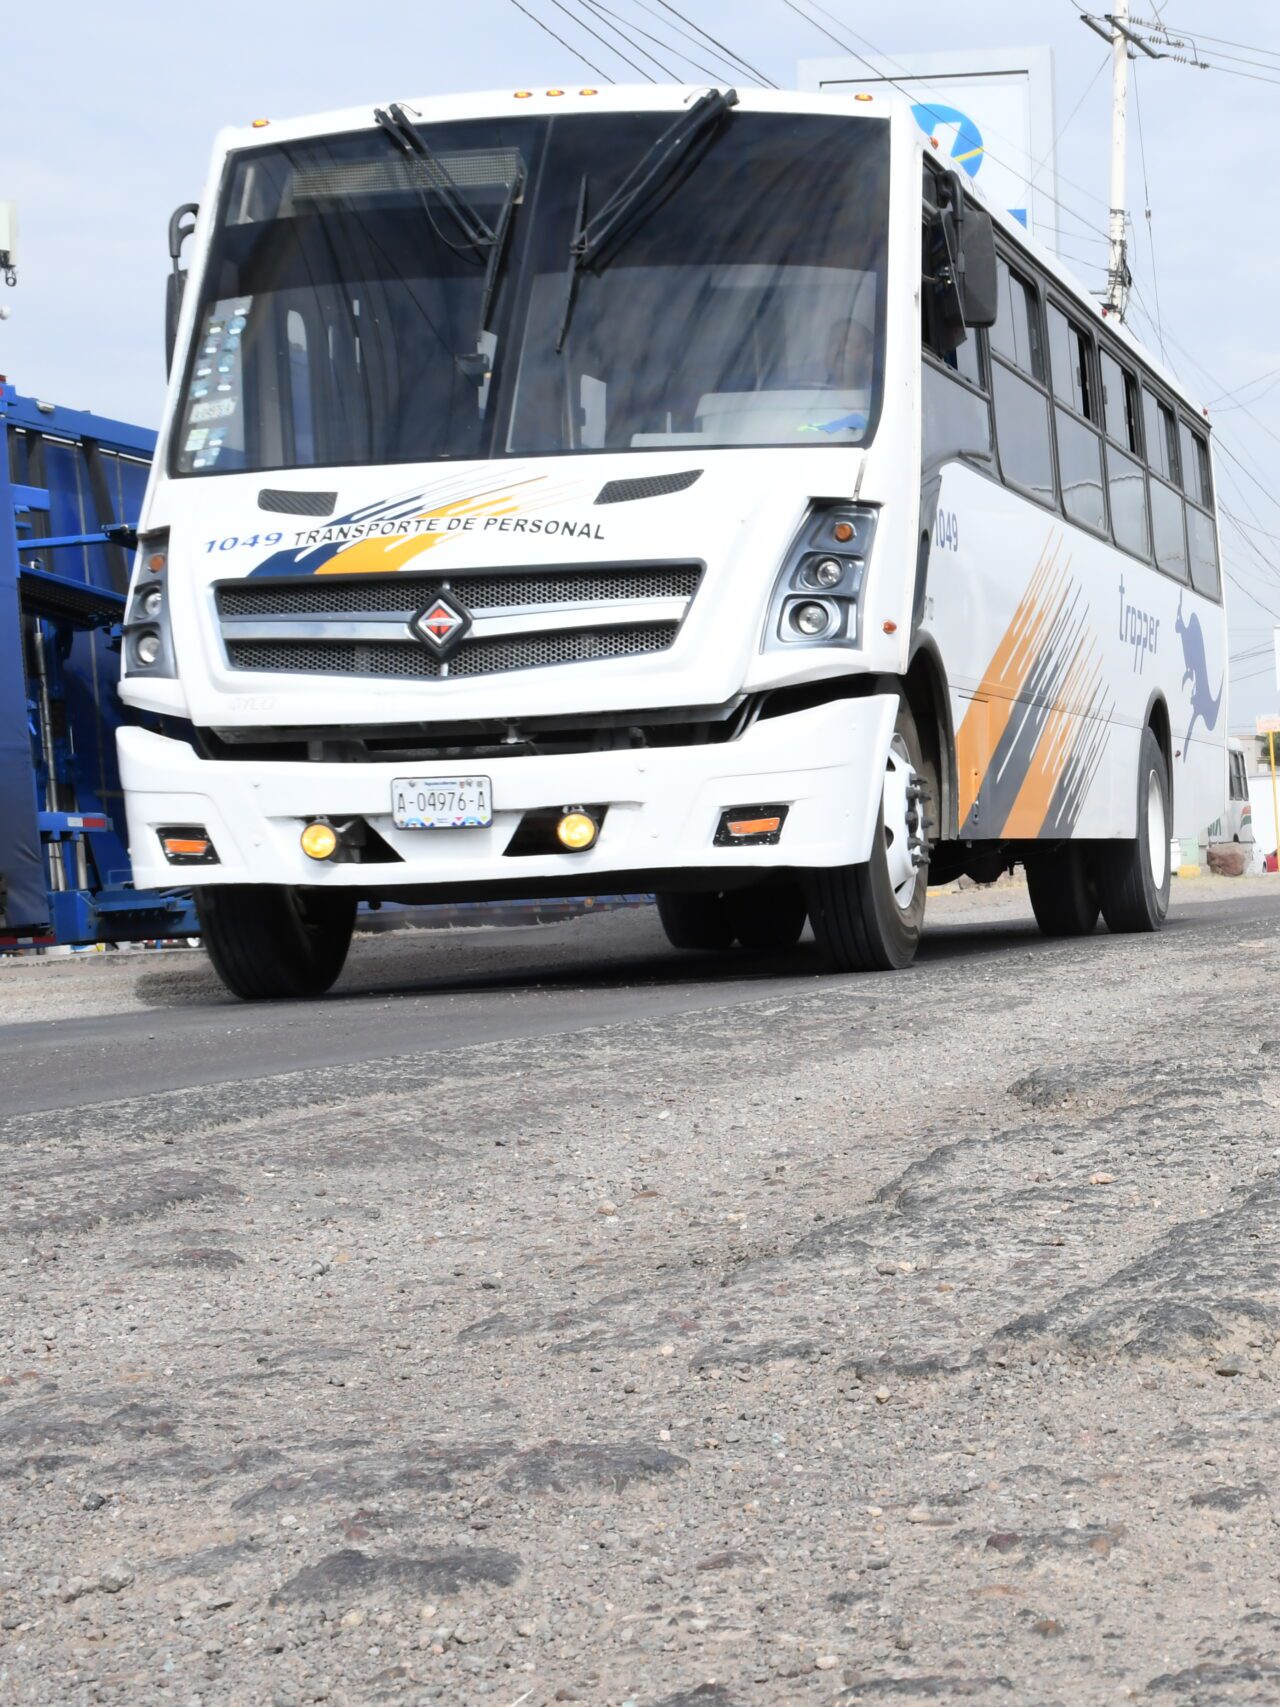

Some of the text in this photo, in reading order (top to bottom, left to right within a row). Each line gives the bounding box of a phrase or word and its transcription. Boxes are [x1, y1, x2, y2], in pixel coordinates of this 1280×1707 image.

[204, 516, 606, 554] 1049 TRANSPORTE DE PERSONAL
[934, 509, 959, 552] 1049
[1118, 572, 1161, 675] tropper
[397, 790, 486, 813] A-04976-A
